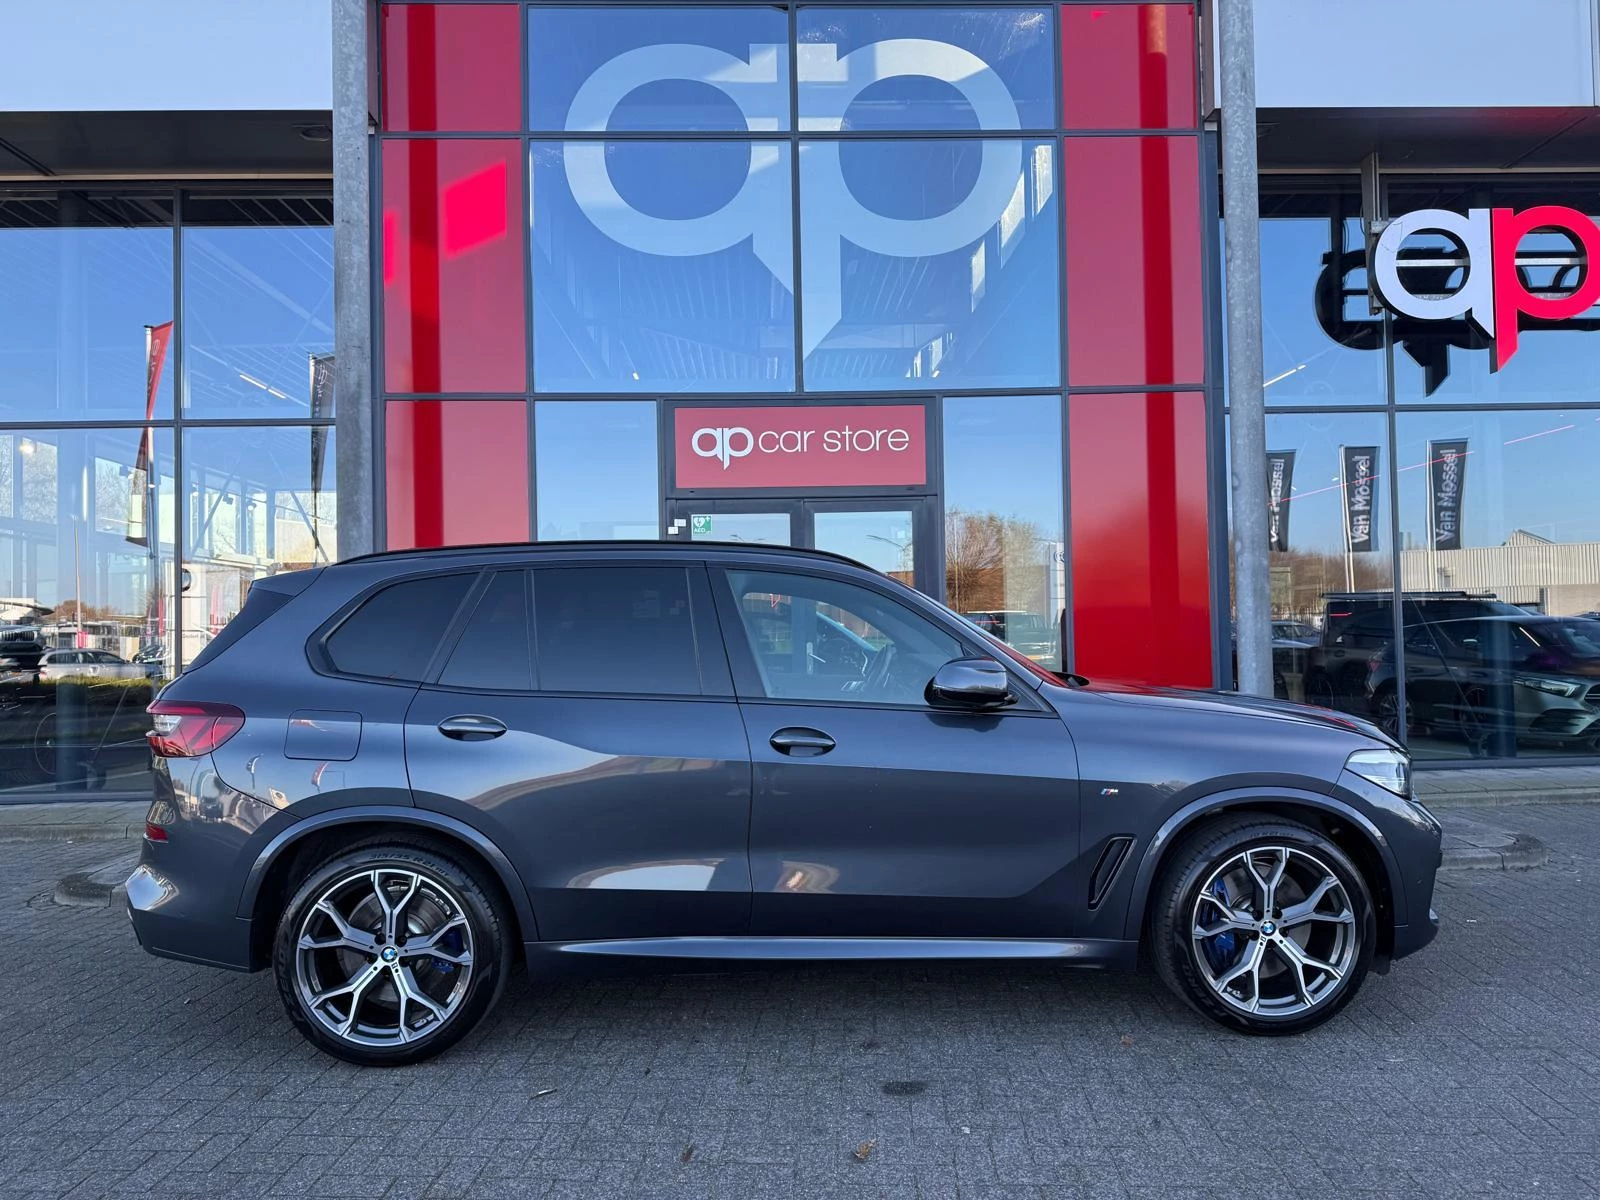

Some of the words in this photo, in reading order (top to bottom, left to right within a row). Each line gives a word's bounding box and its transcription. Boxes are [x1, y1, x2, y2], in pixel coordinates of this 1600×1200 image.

[691, 427, 754, 471] ap
[758, 429, 815, 454] car
[823, 425, 910, 452] store
[1350, 455, 1371, 512] Mossel
[1437, 449, 1458, 507] Mossel
[1350, 512, 1370, 544] Van
[1435, 510, 1457, 544] Van
